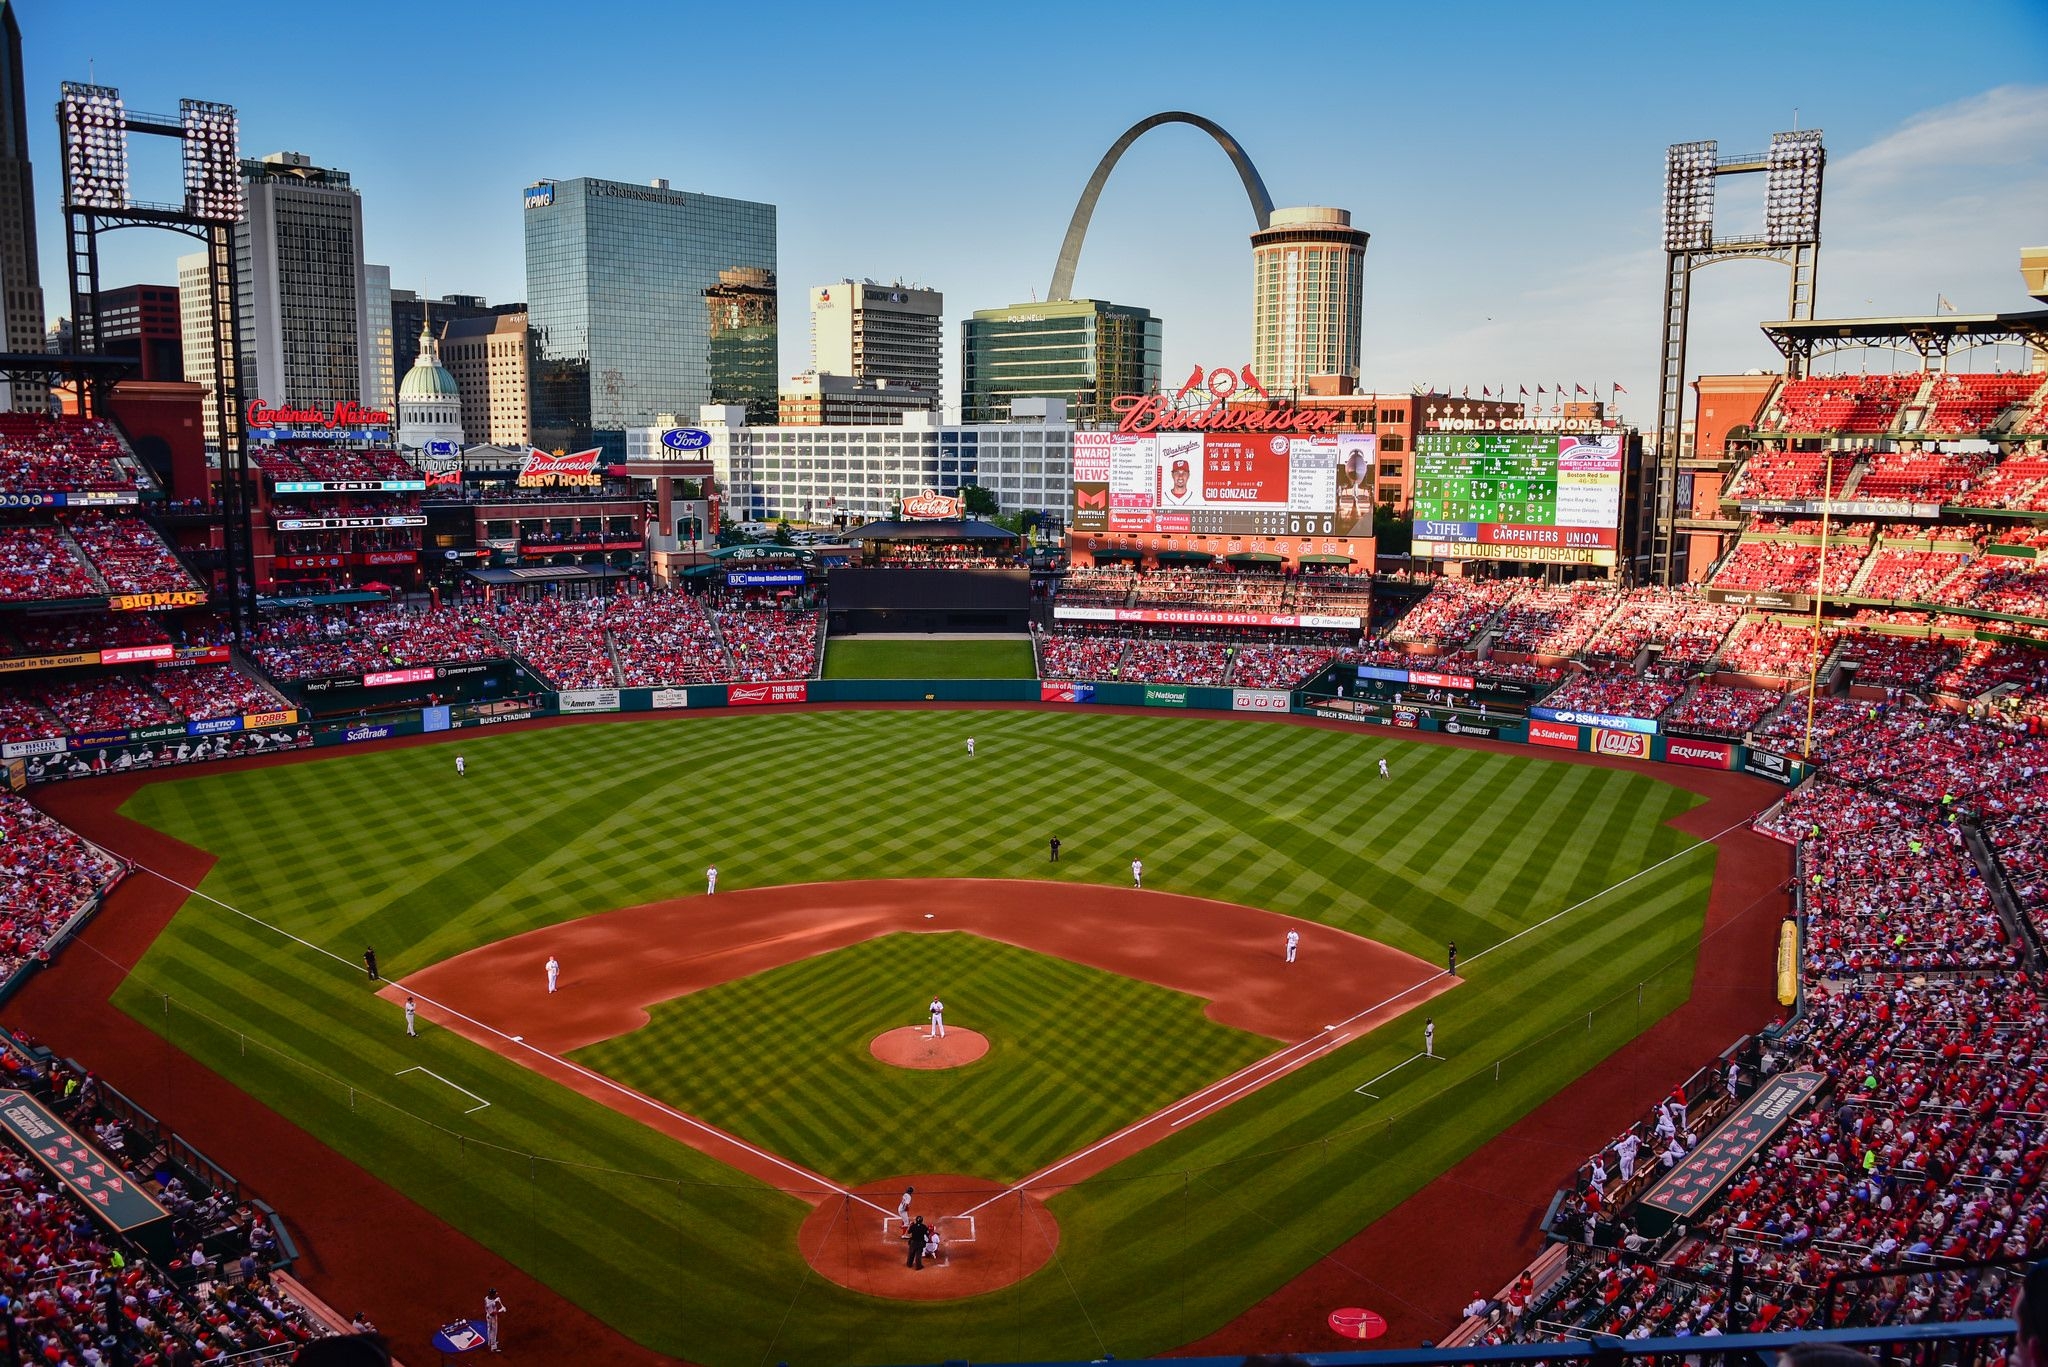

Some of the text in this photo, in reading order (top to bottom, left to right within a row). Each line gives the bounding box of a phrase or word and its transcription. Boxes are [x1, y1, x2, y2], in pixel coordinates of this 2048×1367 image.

[525, 193, 550, 208] KPMG
[606, 184, 687, 207] GREENSFELDER
[1008, 314, 1046, 323] POLSINELLI
[247, 399, 389, 428] Cardinals Nation
[1111, 394, 1339, 433] Budweiser
[1438, 418, 1602, 431] WORLD CHAMPIONS
[673, 431, 703, 446] Ford
[1075, 434, 1110, 445] KMOX
[1075, 448, 1110, 458] AWARD
[1163, 440, 1200, 457] Washington
[420, 460, 463, 472] MIDWEST
[519, 456, 601, 472] Budweiser
[1075, 458, 1110, 467] WINNING
[519, 474, 602, 488] BREW HOUSE
[1075, 469, 1109, 481] NEWS
[1206, 488, 1258, 499] GIO GONZALEZ
[908, 499, 950, 514] Coca-Cola
[1291, 520, 1332, 534] 0 0 0
[1426, 522, 1463, 536] STIFEL
[1493, 529, 1598, 544] CARPENTERS UNION
[1120, 539, 1336, 554] 2 6 9 10 14 17 20 24 42 45 85
[1453, 544, 1593, 562] ST. LOUIS POST-DISPATCH
[731, 575, 744, 583] BJC
[121, 592, 197, 610] BIG MAC
[1724, 594, 1746, 604] Mercy
[1156, 613, 1222, 622] SCOREBOARD
[1228, 615, 1258, 623] PATIO
[152, 648, 172, 656] GOOD
[40, 658, 54, 666] the
[58, 655, 86, 664] count.
[468, 666, 487, 674] JOHN'S
[1476, 683, 1494, 691] Mercy
[1393, 705, 1420, 713] STLFORD
[256, 713, 287, 722] DOBBS
[480, 713, 531, 724] BUSCH STADIUM
[1317, 710, 1365, 722] BUSCH STADIUM
[196, 720, 235, 730] ATHLETICO
[1461, 726, 1490, 735] MIDWEST
[141, 730, 166, 738] Central
[347, 728, 388, 740] Scottrade
[1541, 730, 1576, 741] State Farm
[1670, 746, 1724, 760] EQUIFAX
[1764, 1089, 1800, 1119] CHAMPIONS
